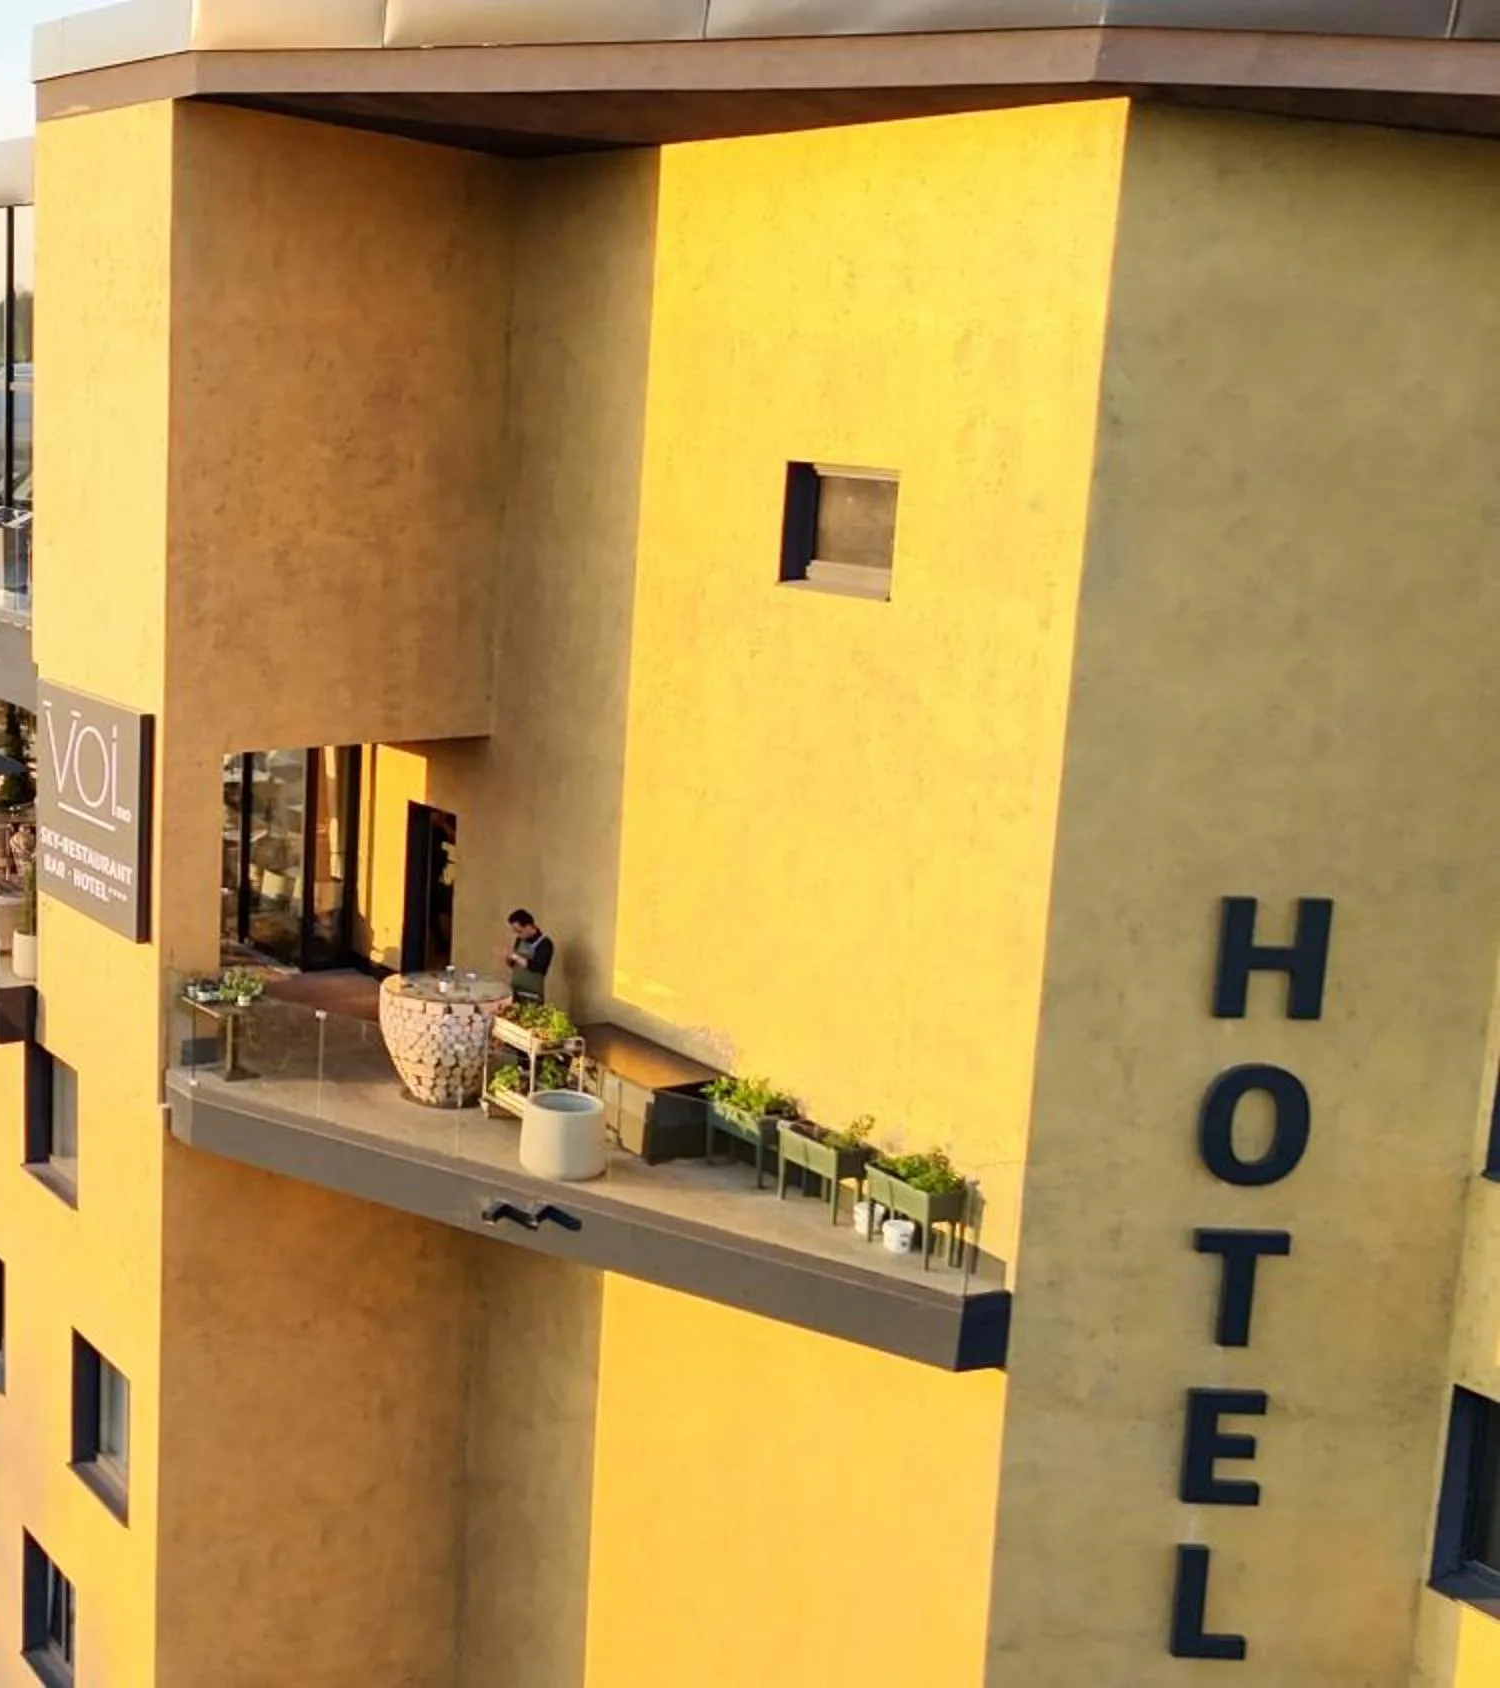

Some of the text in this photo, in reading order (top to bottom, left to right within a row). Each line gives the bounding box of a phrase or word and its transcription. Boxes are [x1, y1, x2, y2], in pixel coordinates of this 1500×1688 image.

[39, 825, 133, 886] SKY-RESTAURANT
[43, 853, 65, 879] BAR
[1169, 896, 1333, 1661] HOTEL
